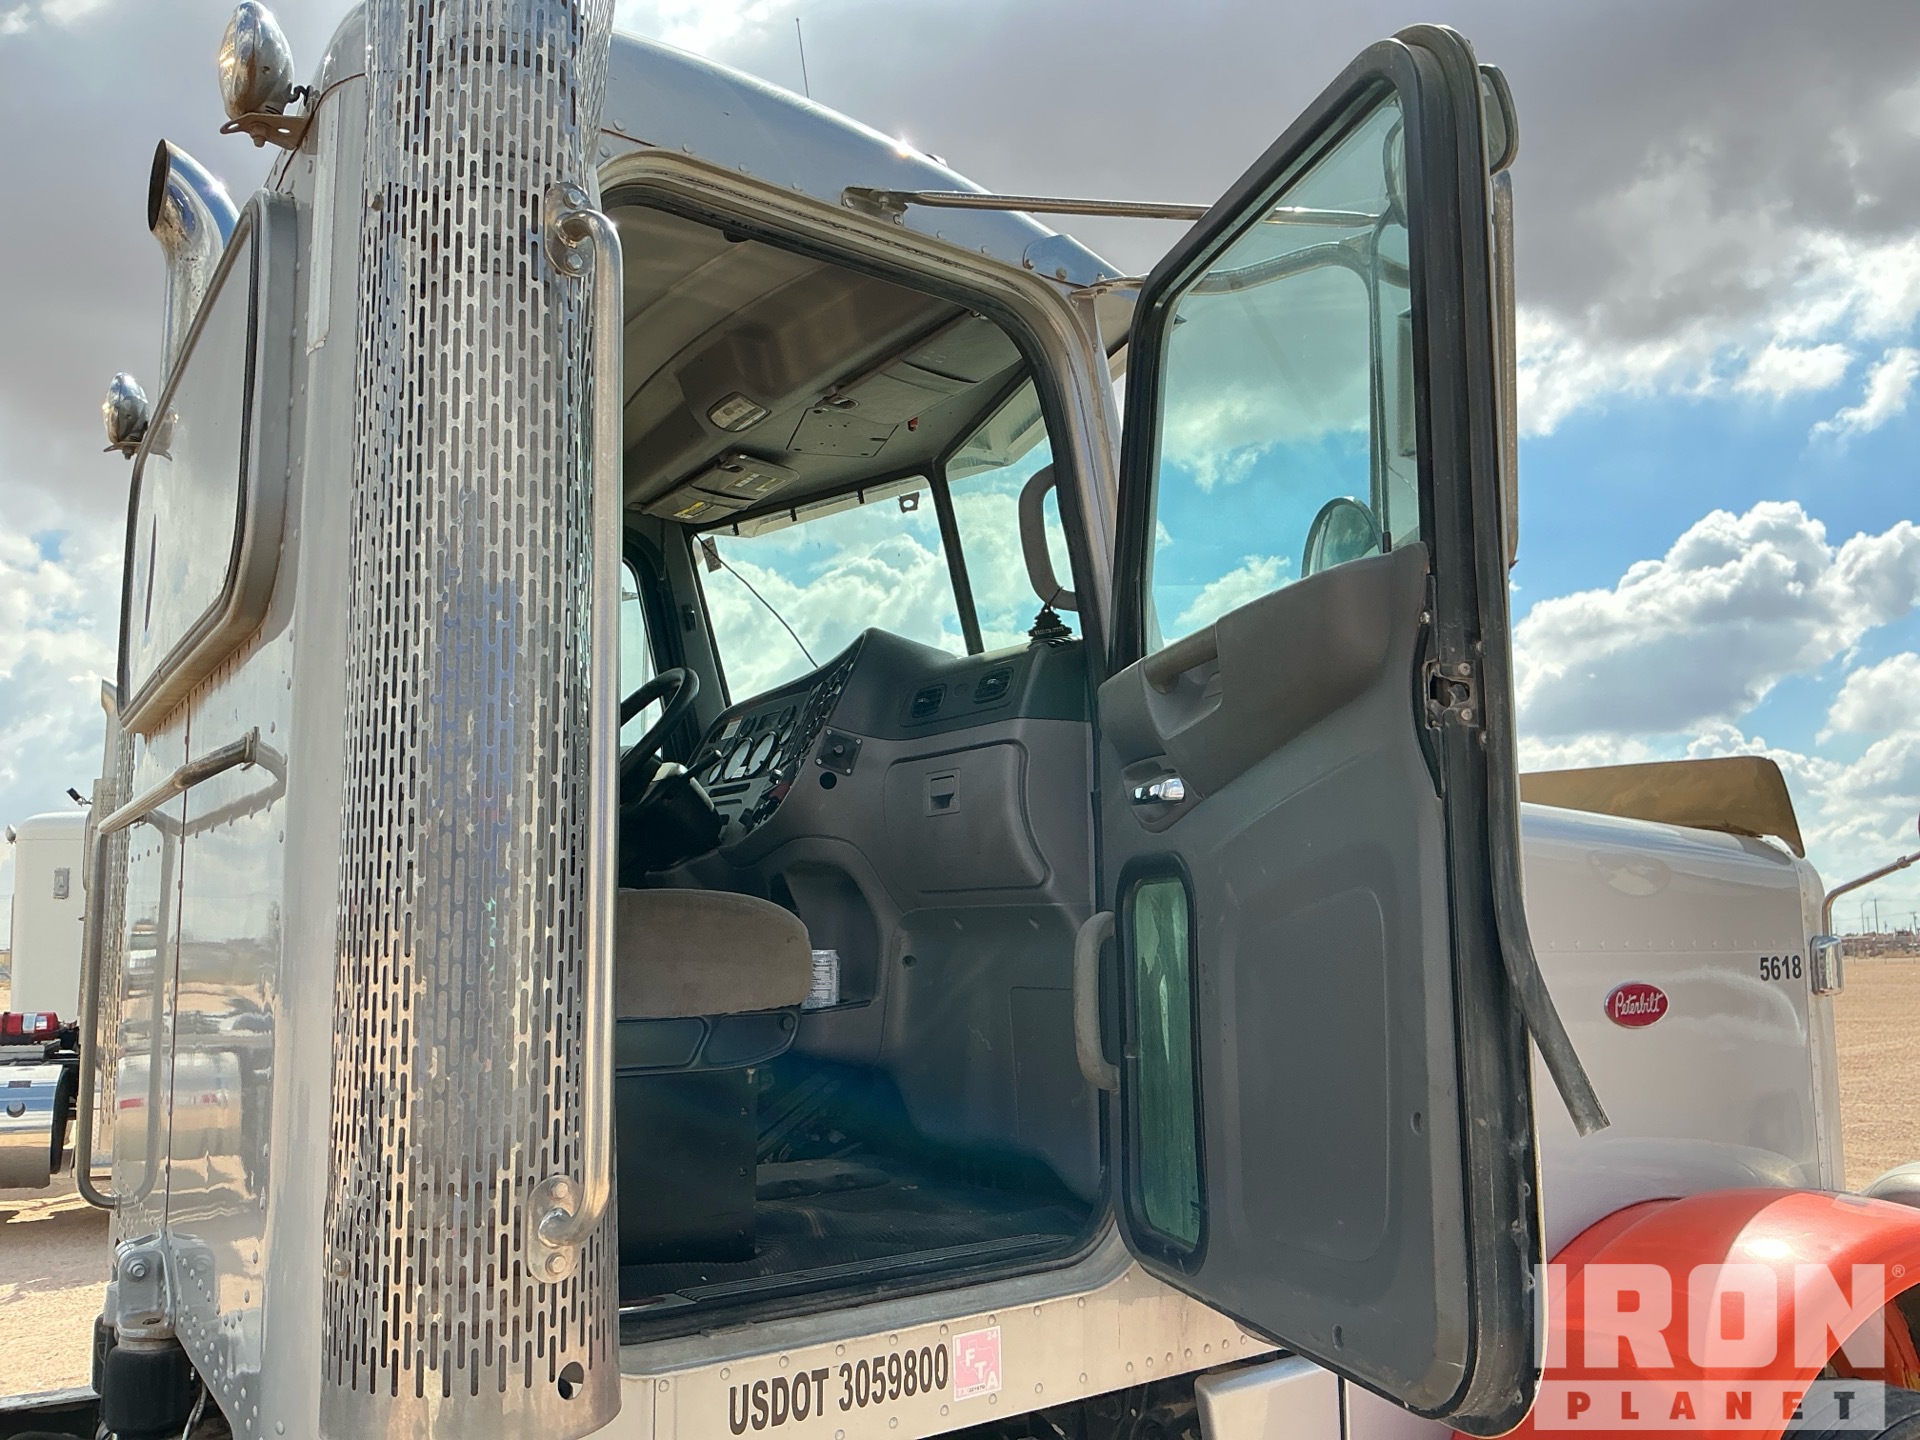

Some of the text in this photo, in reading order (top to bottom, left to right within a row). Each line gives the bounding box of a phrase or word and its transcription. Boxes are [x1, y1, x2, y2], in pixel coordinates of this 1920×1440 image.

[1760, 955, 1801, 981] 5618
[1615, 990, 1664, 1018] Peterbilt
[986, 1330, 998, 1341] 24
[729, 1343, 949, 1436] USDOT 3059800
